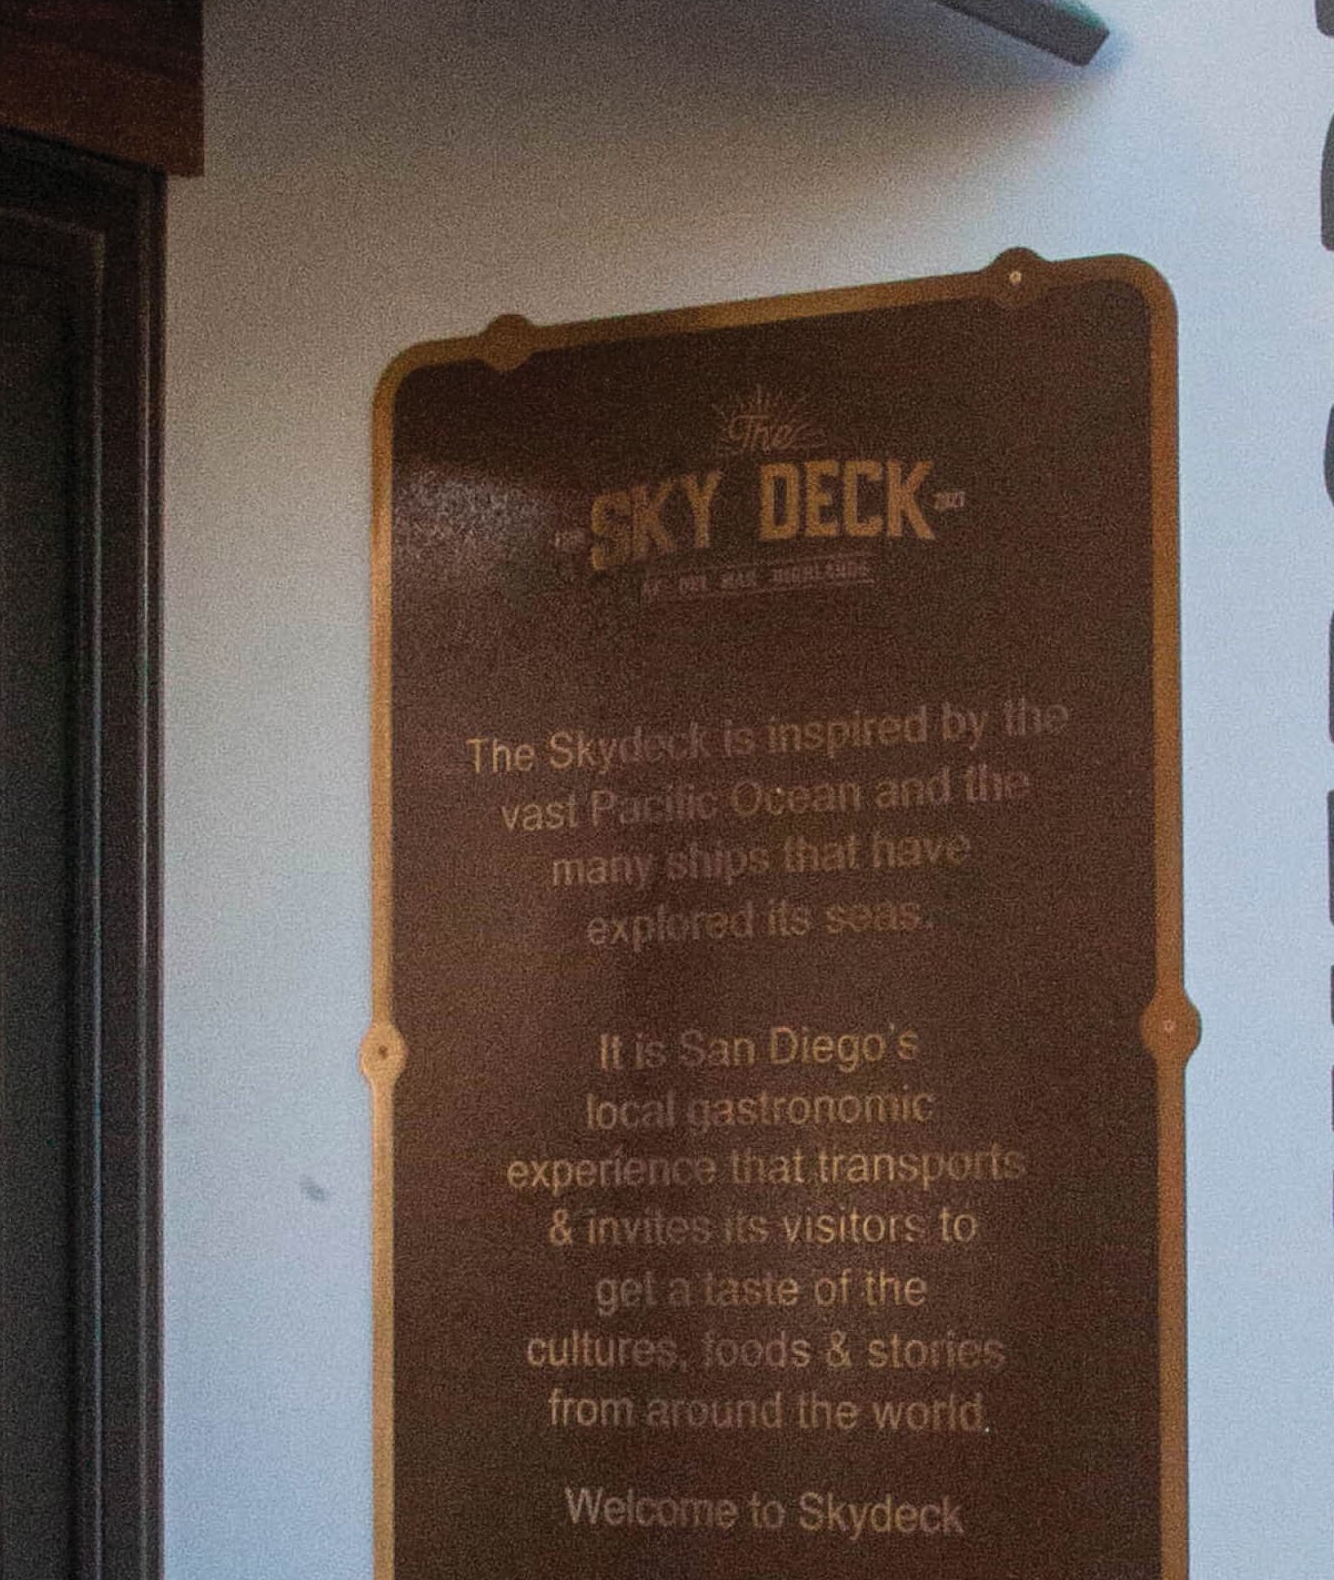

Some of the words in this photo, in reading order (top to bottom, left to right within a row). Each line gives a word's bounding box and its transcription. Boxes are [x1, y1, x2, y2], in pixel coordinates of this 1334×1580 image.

[589, 469, 723, 572] SKY
[758, 459, 937, 542] DECK
[467, 735, 536, 775] The
[548, 722, 711, 775] Skydeck
[724, 717, 756, 759] is
[768, 705, 927, 759] inspired
[942, 699, 989, 748] by
[1003, 695, 1071, 737] the
[501, 794, 578, 835] vast
[591, 783, 719, 827] Pacific
[731, 776, 862, 817] Ocean
[875, 767, 951, 808] and
[964, 761, 1032, 802] the
[550, 852, 652, 892] many
[668, 837, 769, 887] ships
[782, 833, 859, 873] that
[872, 830, 972, 870] have
[586, 900, 753, 953] explored
[767, 896, 811, 937] its
[826, 896, 934, 934] seas.
[599, 1034, 623, 1071] It
[635, 1033, 667, 1070] is
[679, 1030, 756, 1069] San
[770, 1022, 920, 1074] Diego's
[586, 1091, 676, 1131] local
[687, 1084, 935, 1134] gastronomic
[506, 1150, 717, 1196] experience
[730, 1147, 804, 1184] that
[818, 1142, 1027, 1191] transports
[548, 1208, 573, 1246] &
[587, 1207, 712, 1246] invites
[723, 1207, 768, 1244] its
[782, 1205, 925, 1244] visitors
[939, 1206, 979, 1242] to
[595, 1270, 657, 1317] get
[668, 1277, 692, 1306] a
[704, 1270, 801, 1307] taste
[814, 1268, 852, 1306] of
[864, 1268, 928, 1307] the
[526, 1329, 690, 1373] cultures,
[702, 1329, 812, 1368] foods
[827, 1330, 852, 1368] &
[867, 1329, 1007, 1369] stories
[548, 1387, 635, 1428] from
[646, 1388, 783, 1429] around
[796, 1390, 860, 1430] the
[871, 1391, 992, 1435] world.
[563, 1485, 738, 1530] Welcome
[750, 1491, 786, 1531] to
[797, 1489, 966, 1542] Skydeck
